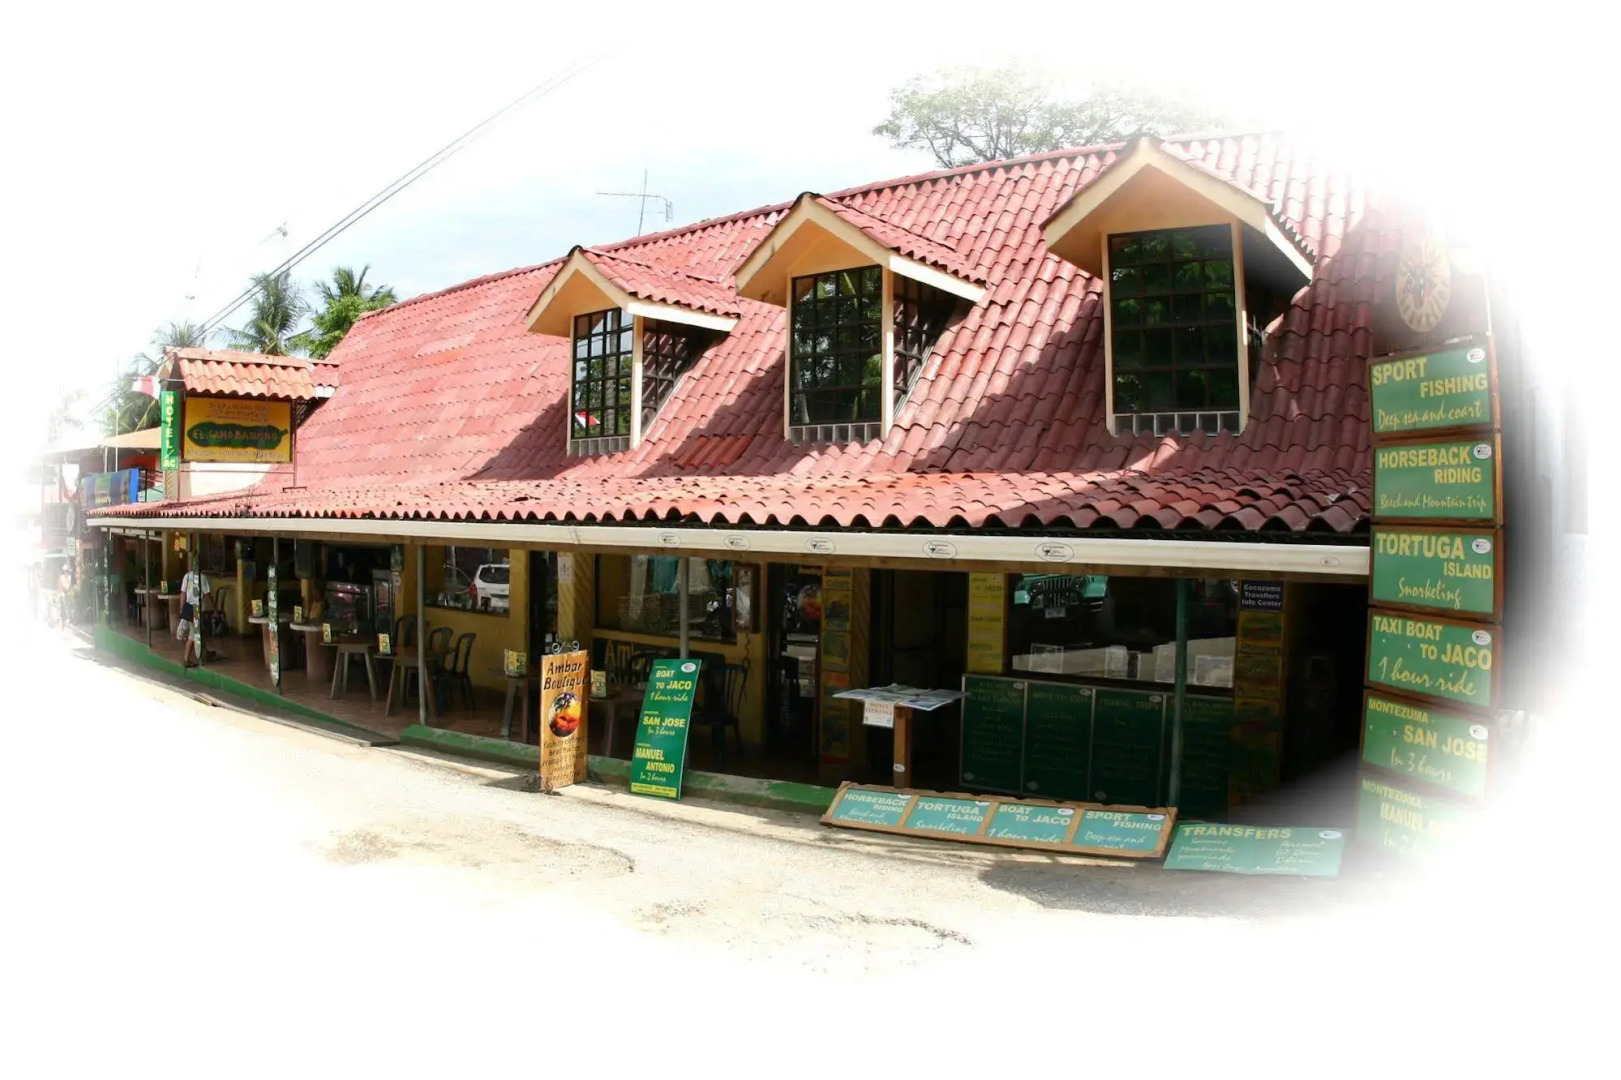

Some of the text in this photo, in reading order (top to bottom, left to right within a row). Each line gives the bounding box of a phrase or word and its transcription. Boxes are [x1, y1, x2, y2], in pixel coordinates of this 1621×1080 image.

[1372, 357, 1428, 386] SPORT
[1419, 373, 1488, 398] FISHING
[1378, 409, 1400, 431] Deep
[1401, 411, 1421, 425] sea
[1421, 400, 1446, 422] and
[1378, 446, 1472, 469] HORSEBACK
[1434, 467, 1482, 484] RIDING
[1403, 492, 1421, 508] and
[1422, 493, 1465, 509] Mountain
[1466, 495, 1487, 513] trip
[1376, 532, 1466, 560] TORTUGA
[1443, 561, 1492, 579] ISLAND
[1398, 576, 1463, 610] Snorkeling
[1374, 616, 1443, 641] TAXI BOAT
[1420, 642, 1492, 671] TO JACO
[547, 660, 582, 676] Ambar
[655, 670, 675, 678] BOAT
[1378, 655, 1476, 697] 1 hour ride
[544, 675, 588, 691] Boutique
[666, 681, 692, 690] JACO
[654, 691, 671, 701] hour
[673, 692, 689, 702] ride
[1368, 699, 1430, 724] MONTEZUMA
[643, 716, 686, 728] SAN JOSE
[648, 726, 654, 734] In
[660, 726, 675, 736] hours
[1403, 724, 1438, 749] SAN
[1441, 736, 1488, 763] JOSE
[636, 747, 664, 760] MANUEL
[646, 761, 675, 773] ANTONIO
[1390, 748, 1453, 782] In 3 hours
[651, 772, 666, 782] hours
[844, 793, 908, 808] HORSEBACK
[1362, 779, 1423, 808] MONTEZUMA
[873, 803, 904, 813] RIDING
[917, 801, 980, 815] TORTUGA
[999, 804, 1034, 815] BOAT
[1086, 810, 1132, 821] SPORT
[947, 812, 984, 822] ISLAND
[1015, 814, 1071, 826] TO JACO
[1380, 801, 1425, 833] MANUEL
[988, 828, 996, 838] 1
[1112, 820, 1162, 832] FISHING
[1183, 826, 1292, 840] TRANSFERS
